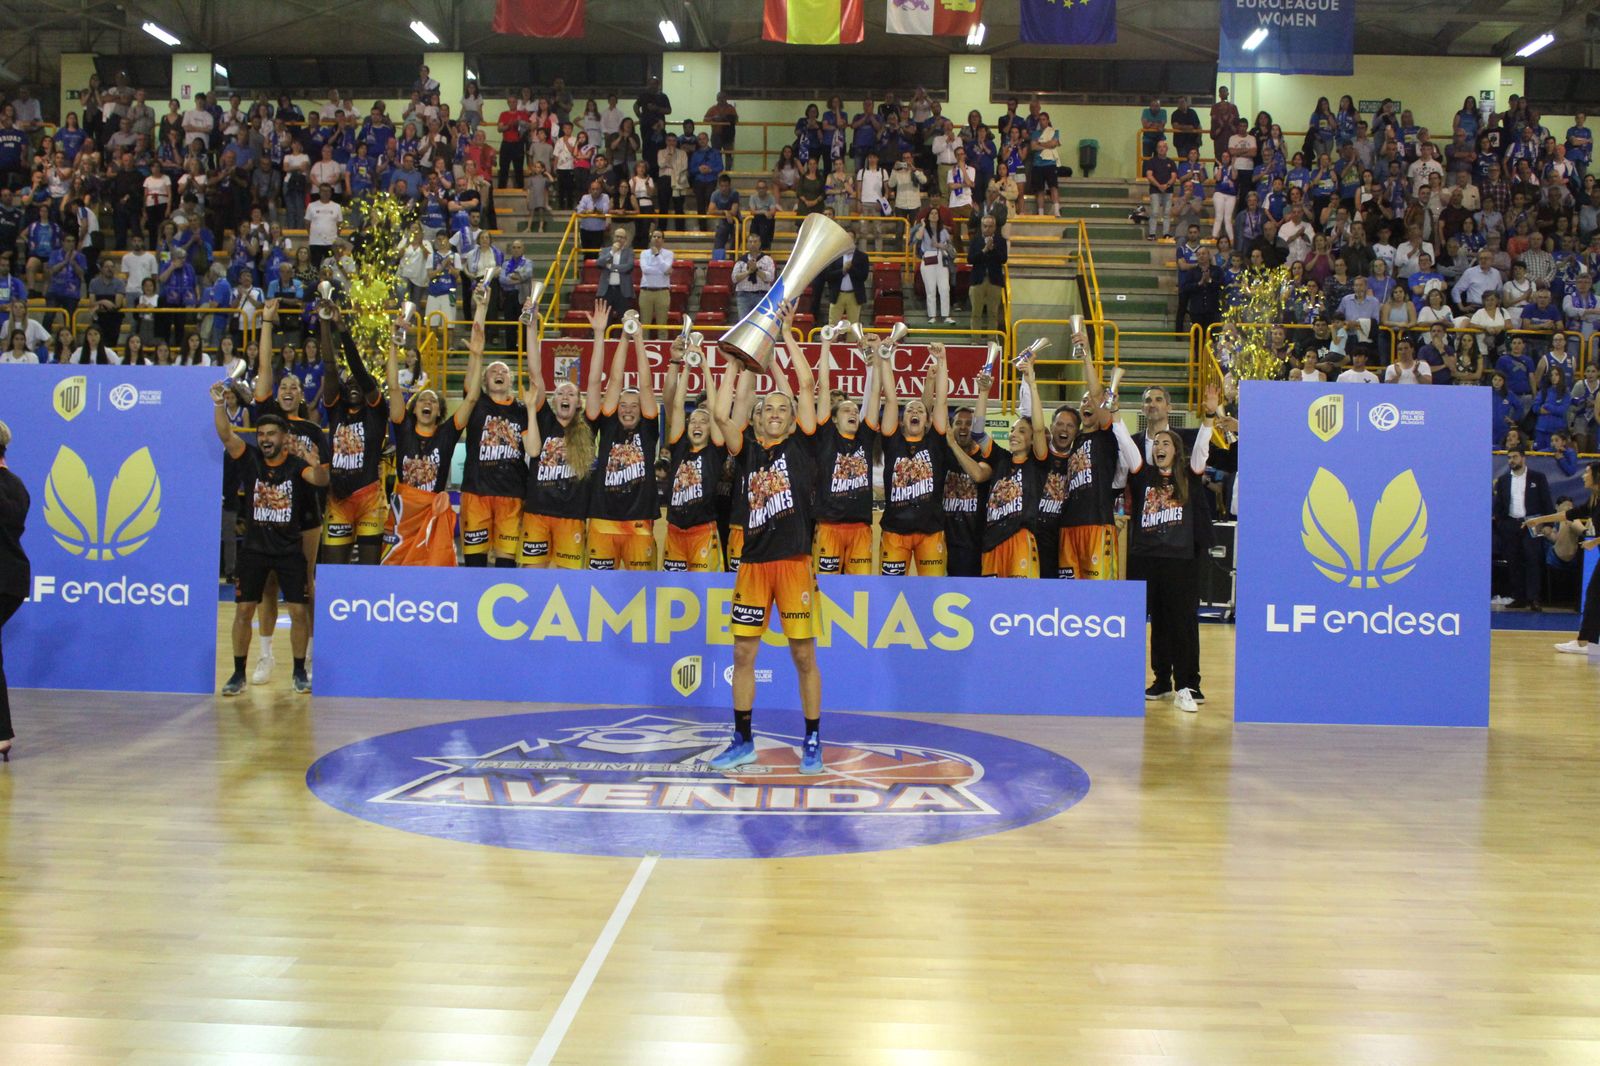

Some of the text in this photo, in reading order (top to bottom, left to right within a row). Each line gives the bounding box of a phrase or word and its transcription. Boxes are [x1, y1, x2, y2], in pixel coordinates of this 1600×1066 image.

[1257, 12, 1317, 27] WOMEN
[60, 385, 80, 413] 100
[1315, 404, 1337, 434] 100
[604, 461, 646, 487] CAMPIONES
[890, 478, 934, 502] CAMPIONES
[986, 496, 1023, 522] AMPIONES
[1141, 506, 1183, 528] CAMPIONES
[664, 560, 686, 568] PULEVA
[24, 575, 190, 606] F endesa
[329, 592, 459, 623] endesa
[477, 582, 975, 651] CAMPENAS
[734, 605, 764, 616] PULEVA
[781, 611, 811, 619] zummo
[1266, 604, 1460, 636] LF endesa
[989, 607, 1126, 639] endesa
[677, 664, 696, 690] 100
[411, 775, 967, 810] AVENIDA
